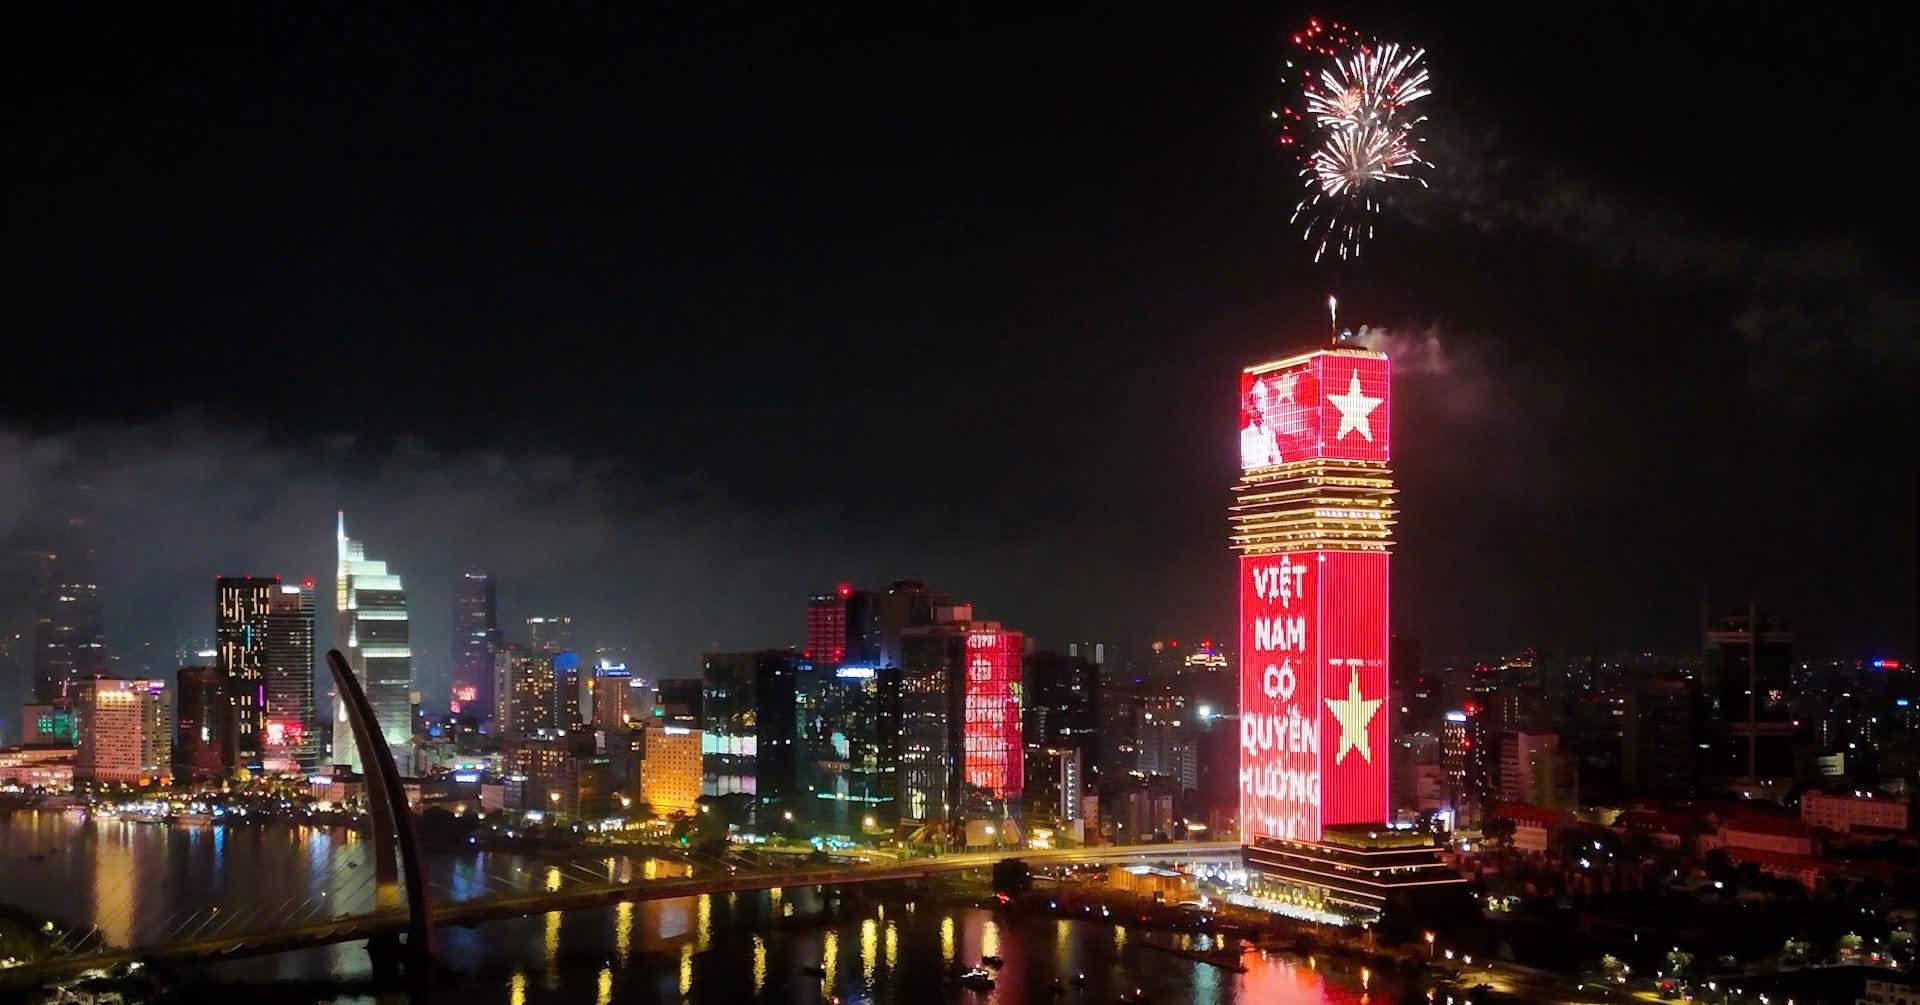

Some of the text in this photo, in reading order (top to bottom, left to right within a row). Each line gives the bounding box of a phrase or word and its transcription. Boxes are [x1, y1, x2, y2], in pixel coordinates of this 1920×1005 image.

[1253, 554, 1308, 608] VIỆT
[1255, 616, 1305, 652] NAM
[1263, 657, 1296, 701] CÓ
[1241, 704, 1318, 757] QUYỀN
